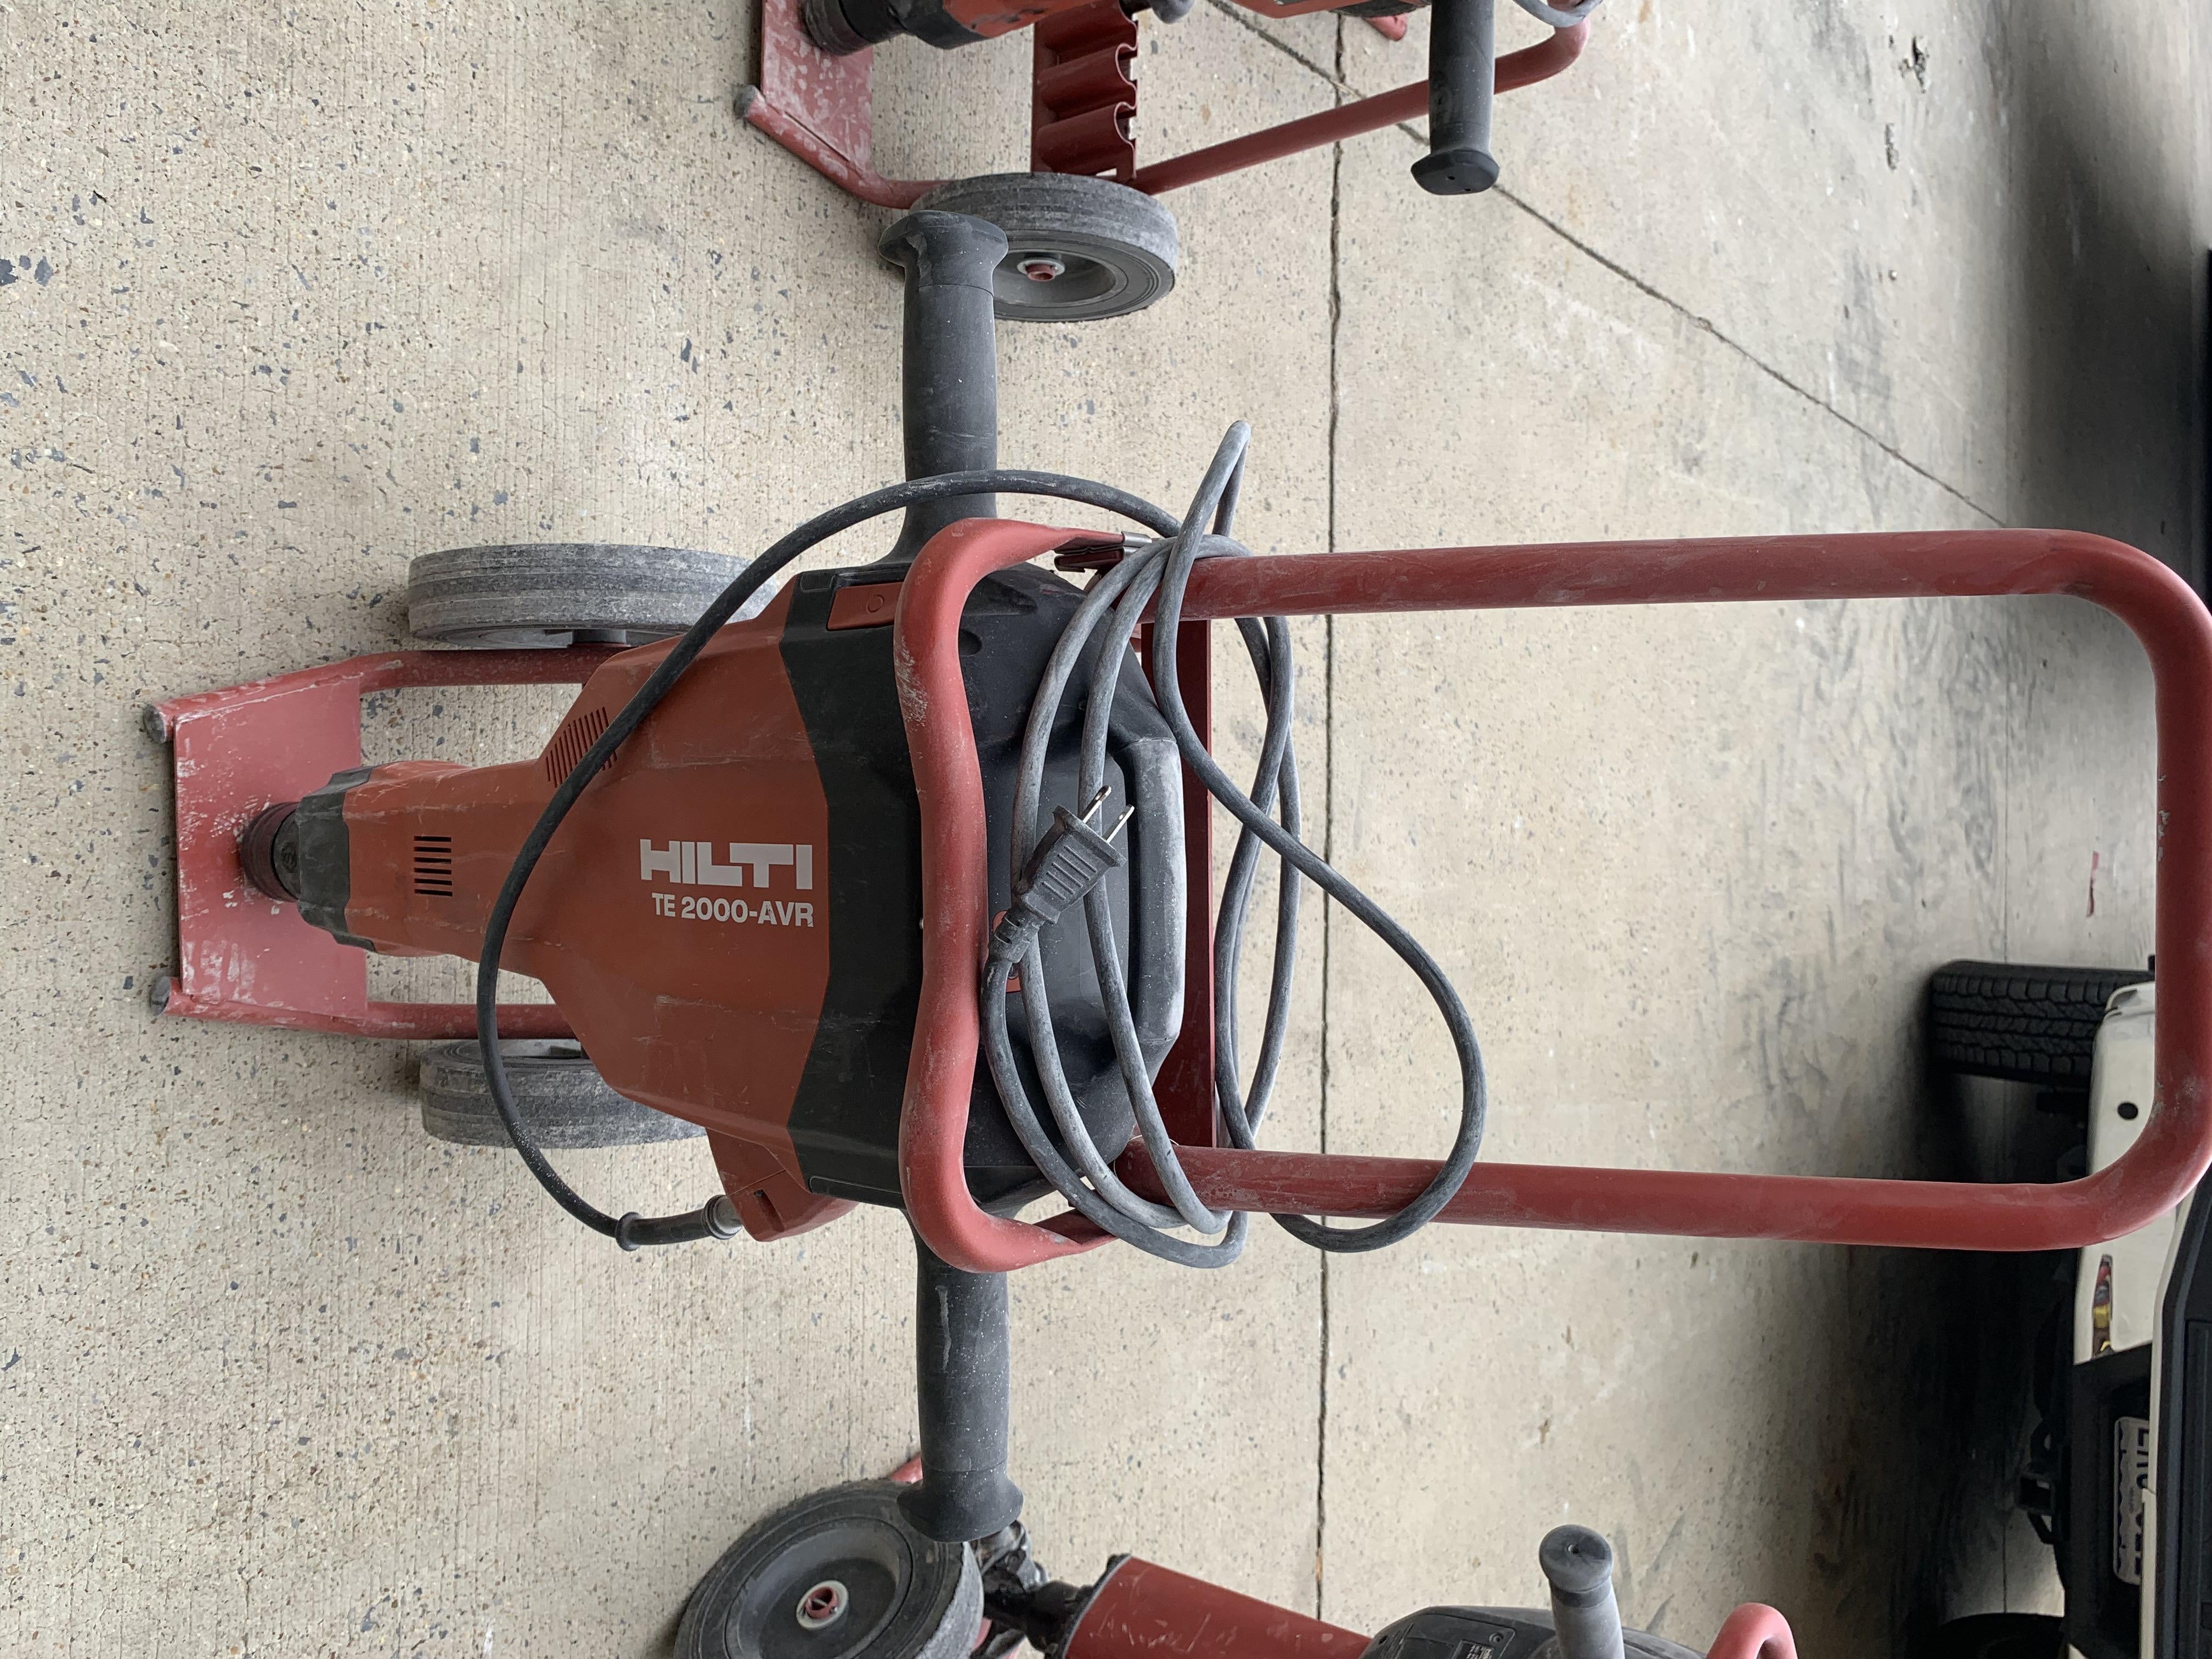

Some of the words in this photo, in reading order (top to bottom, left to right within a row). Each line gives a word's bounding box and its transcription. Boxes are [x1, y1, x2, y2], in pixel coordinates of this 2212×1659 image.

[640, 838, 813, 890] HILTI
[651, 892, 676, 917] TE
[681, 896, 814, 927] 2000-AVR
